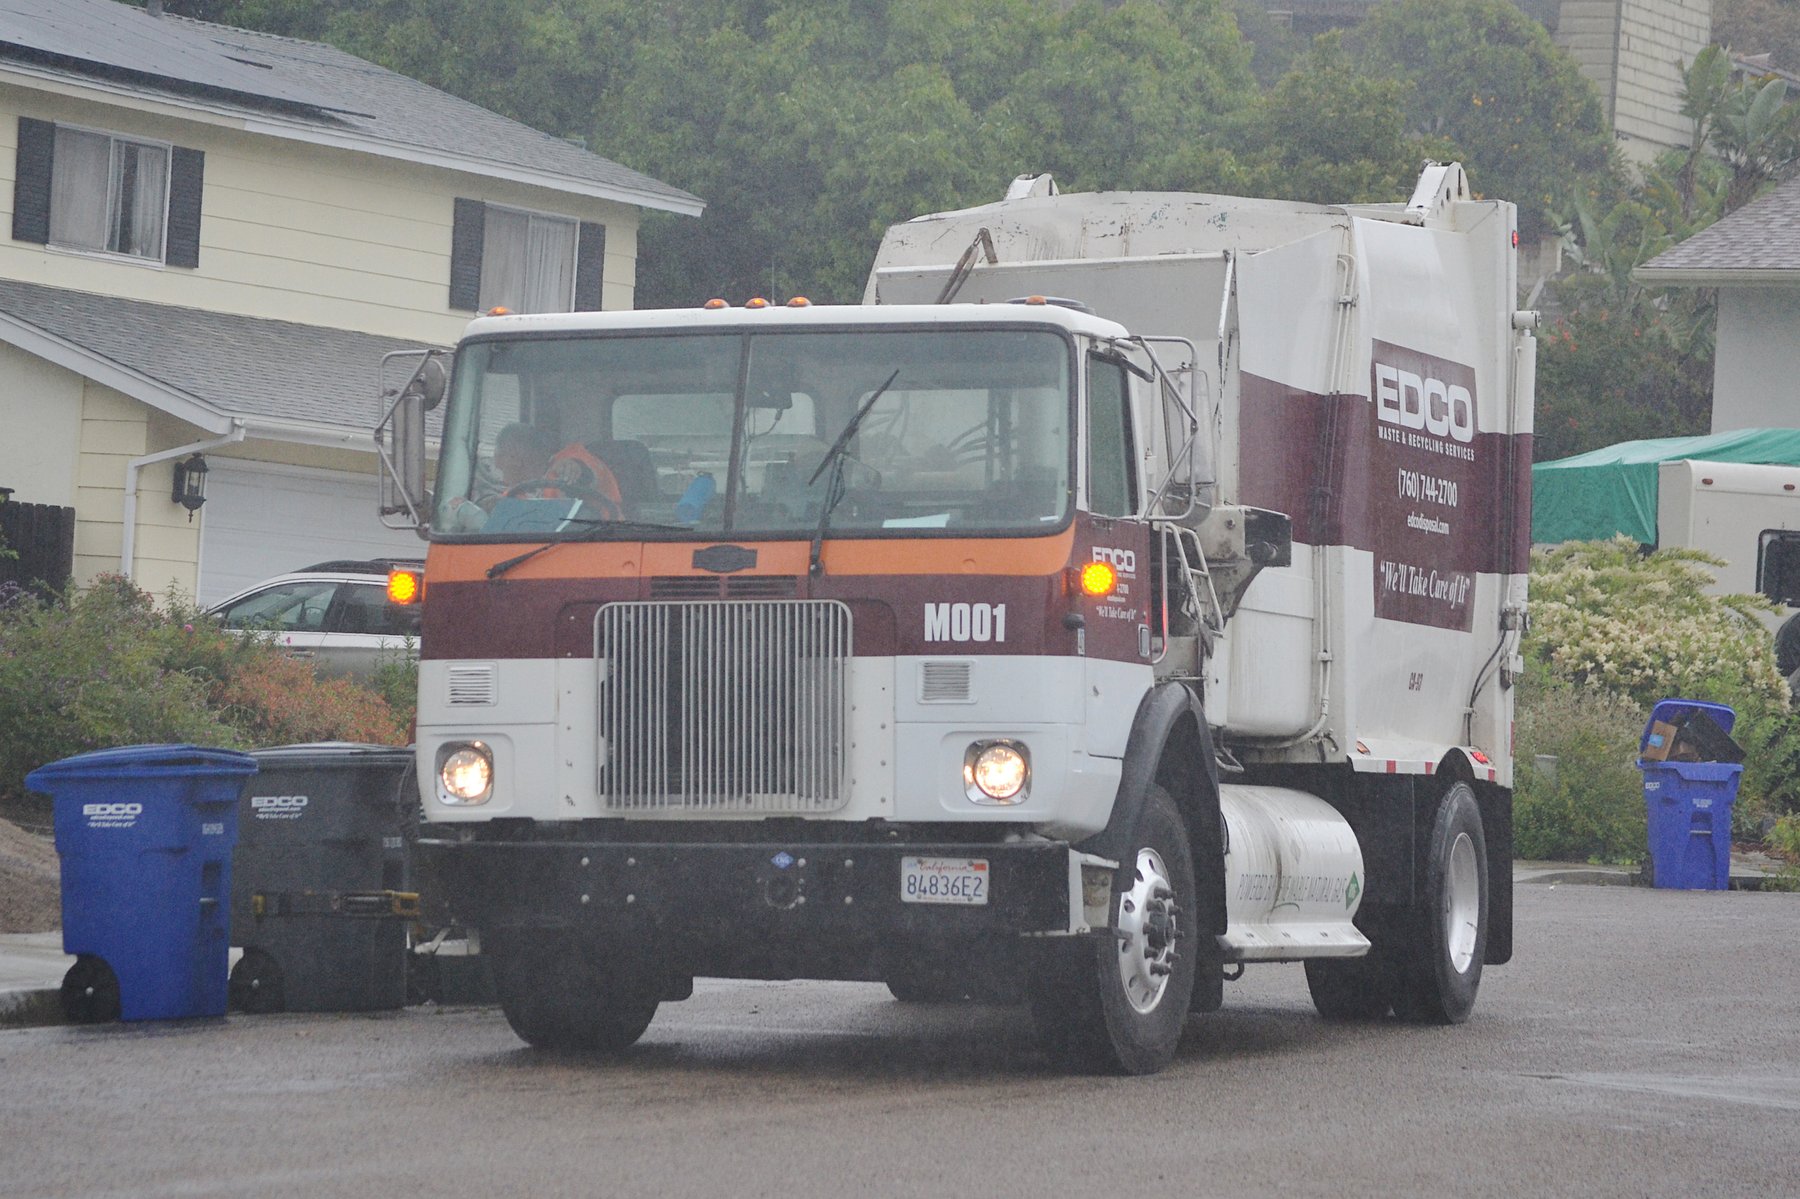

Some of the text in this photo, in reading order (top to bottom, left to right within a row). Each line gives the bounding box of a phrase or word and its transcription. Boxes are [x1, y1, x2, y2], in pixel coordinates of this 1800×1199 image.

[1375, 362, 1474, 443] EDCO
[1378, 425, 1475, 462] WASTE & RECYCLING SERVICES
[1398, 467, 1458, 508] (760) 744-2700
[1092, 546, 1136, 572] EDCO
[1408, 566, 1428, 597] Take
[1429, 569, 1448, 601] Care
[1448, 574, 1460, 610] of
[924, 602, 1006, 642] M001
[83, 803, 143, 815] EDCO
[252, 795, 308, 808] EDCO
[919, 861, 968, 874] California
[906, 874, 983, 897] 84836E2
